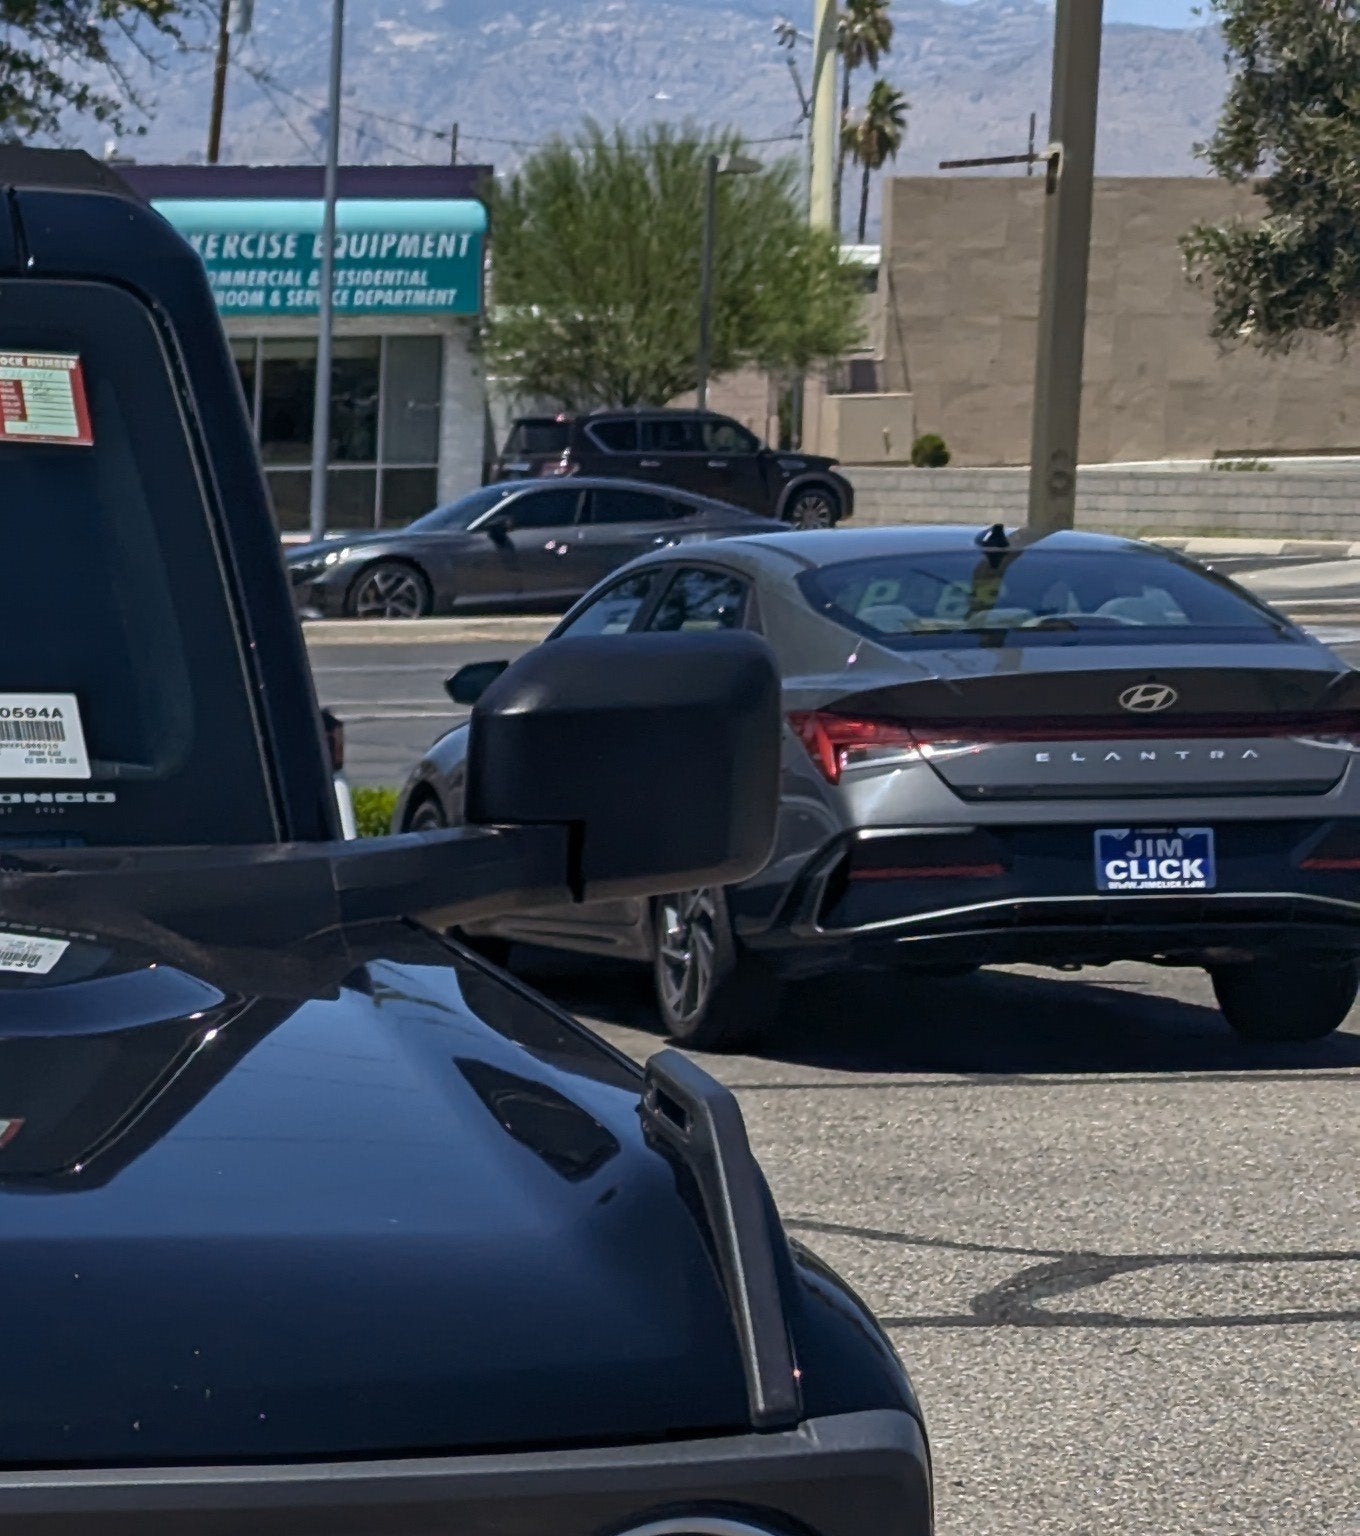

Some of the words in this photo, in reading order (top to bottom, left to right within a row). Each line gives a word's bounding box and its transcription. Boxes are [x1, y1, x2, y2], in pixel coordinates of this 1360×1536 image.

[188, 232, 298, 259] XERCISE
[312, 232, 472, 259] EQUIPMENT
[206, 269, 302, 287] OMMERCIAL
[332, 269, 429, 287] ESIDENTIAL
[269, 289, 281, 307] &
[286, 289, 350, 307] SERVCE
[353, 288, 458, 306] DEPARTMENT
[1035, 749, 1259, 763] ELANTRA
[1125, 838, 1184, 858] JIM
[1105, 857, 1205, 880] CLICK
